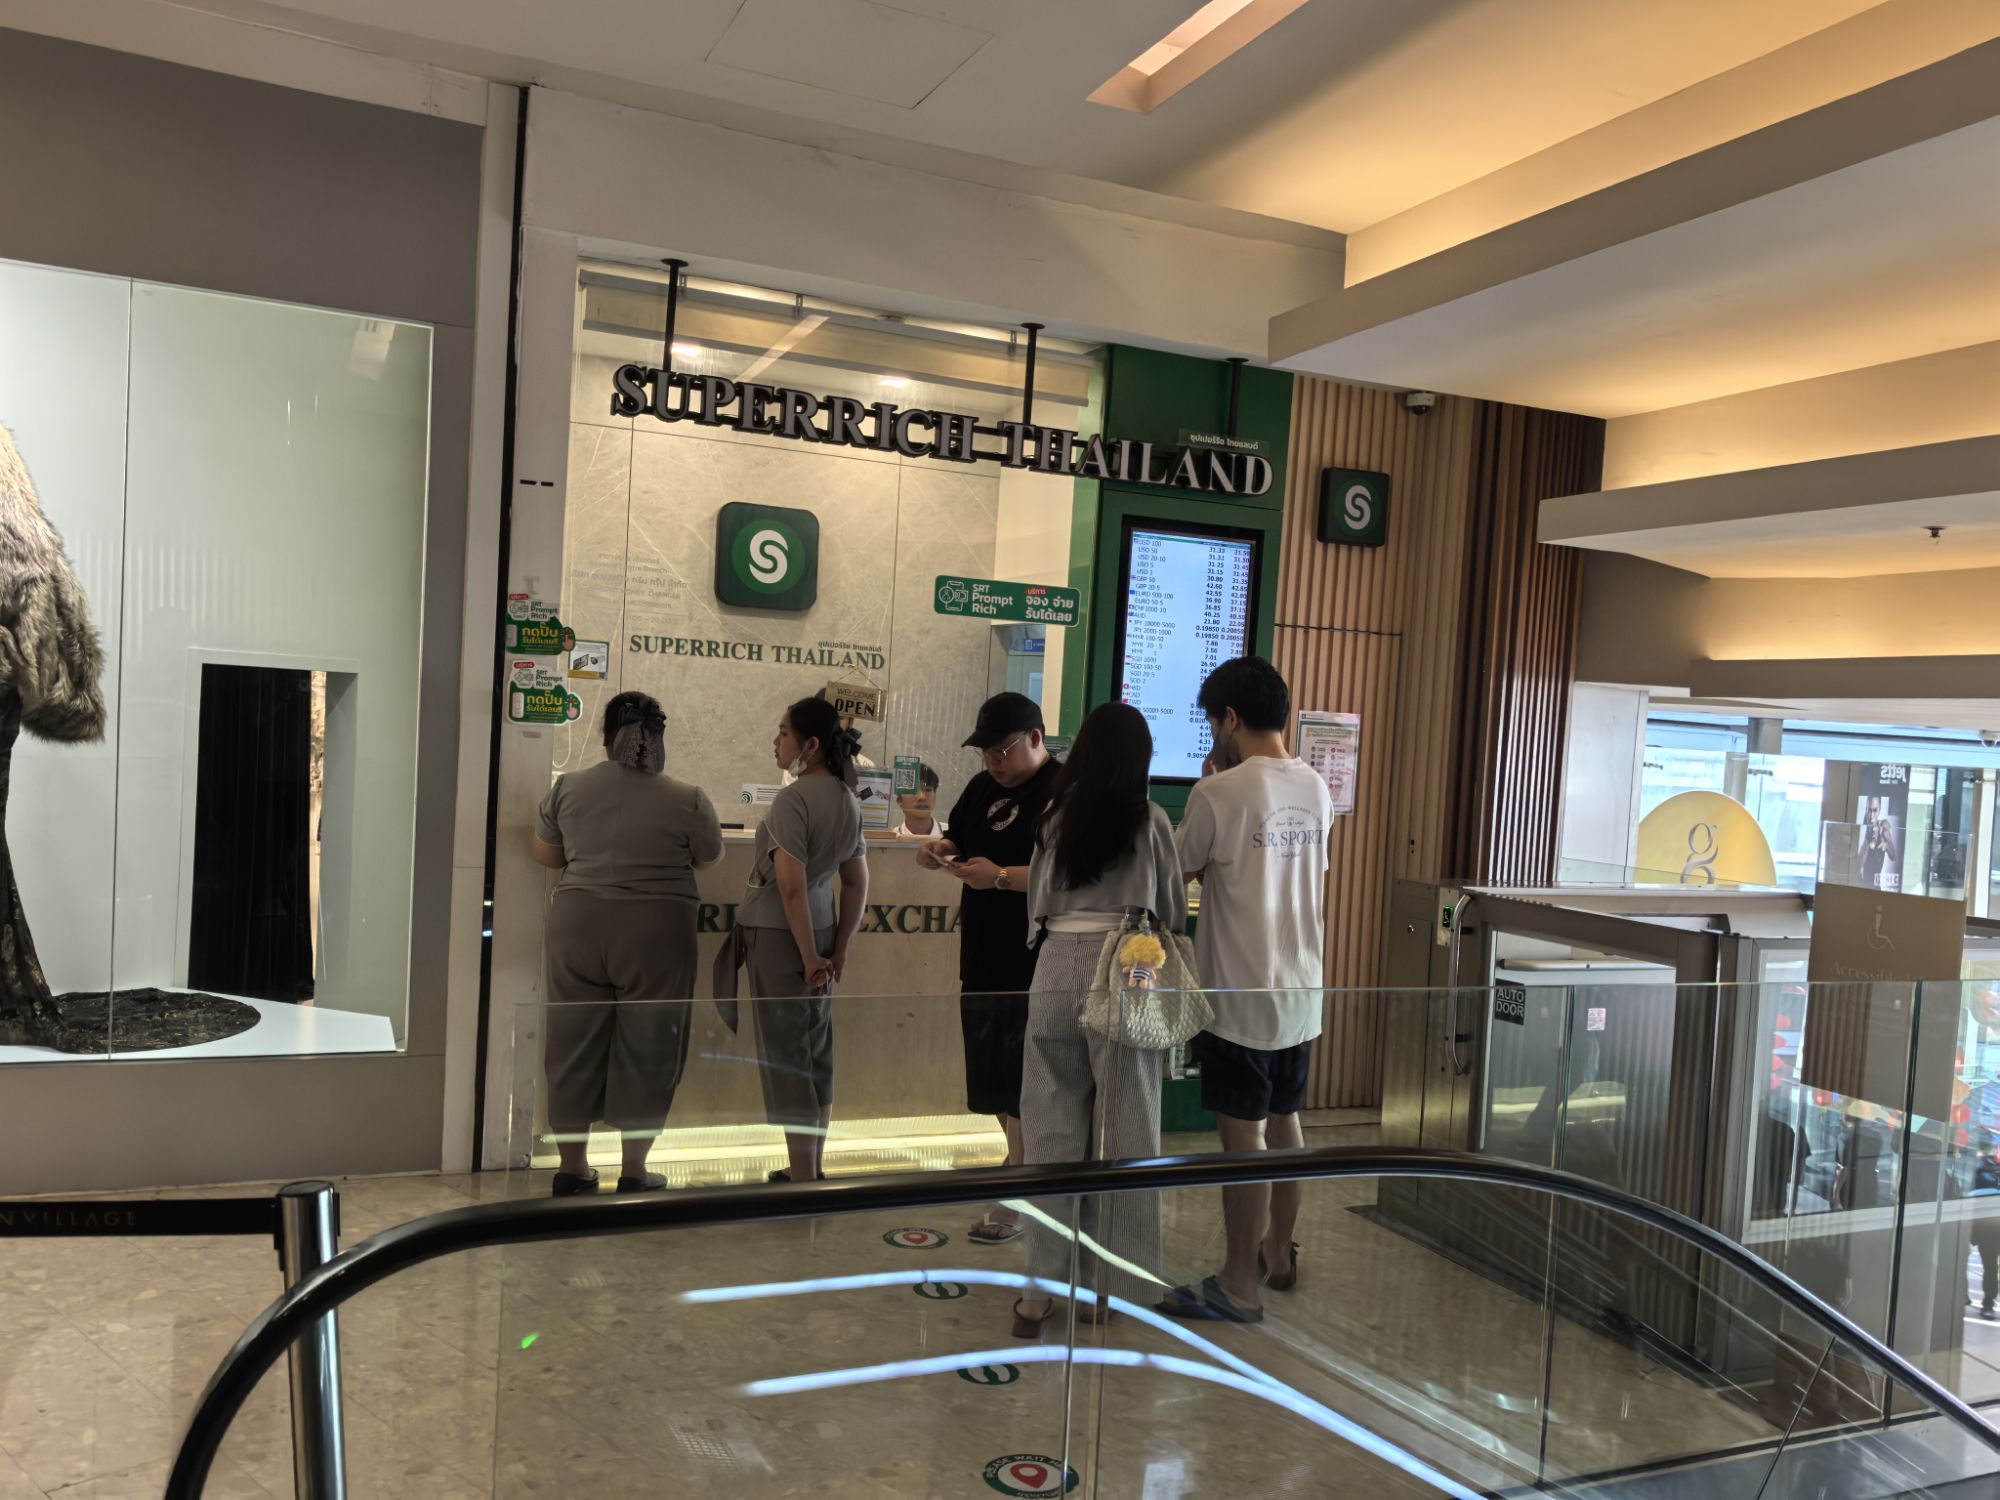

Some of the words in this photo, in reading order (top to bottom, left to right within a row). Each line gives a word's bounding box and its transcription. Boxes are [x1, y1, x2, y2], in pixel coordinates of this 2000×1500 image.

[611, 364, 978, 463] SUPERRICH
[997, 420, 1273, 497] THAILAND
[972, 583, 990, 593] SRT
[972, 593, 1013, 607] Prompt
[1026, 596, 1049, 606] จอง
[1052, 595, 1074, 608] จ่าย
[972, 604, 997, 615] Rich
[1026, 606, 1072, 622] รับได้เลย
[629, 634, 762, 661] SUPERRICH
[771, 645, 885, 670] THAILAND
[536, 674, 562, 683] Prompt
[836, 688, 877, 699] WELCOME
[835, 698, 875, 717] OPEN
[1252, 832, 1277, 848] S.R.
[1281, 830, 1324, 846] SPORT
[1497, 988, 1524, 1002] AUTO
[1496, 1000, 1524, 1017] DOOR
[23, 1211, 136, 1226] VILLAGE
